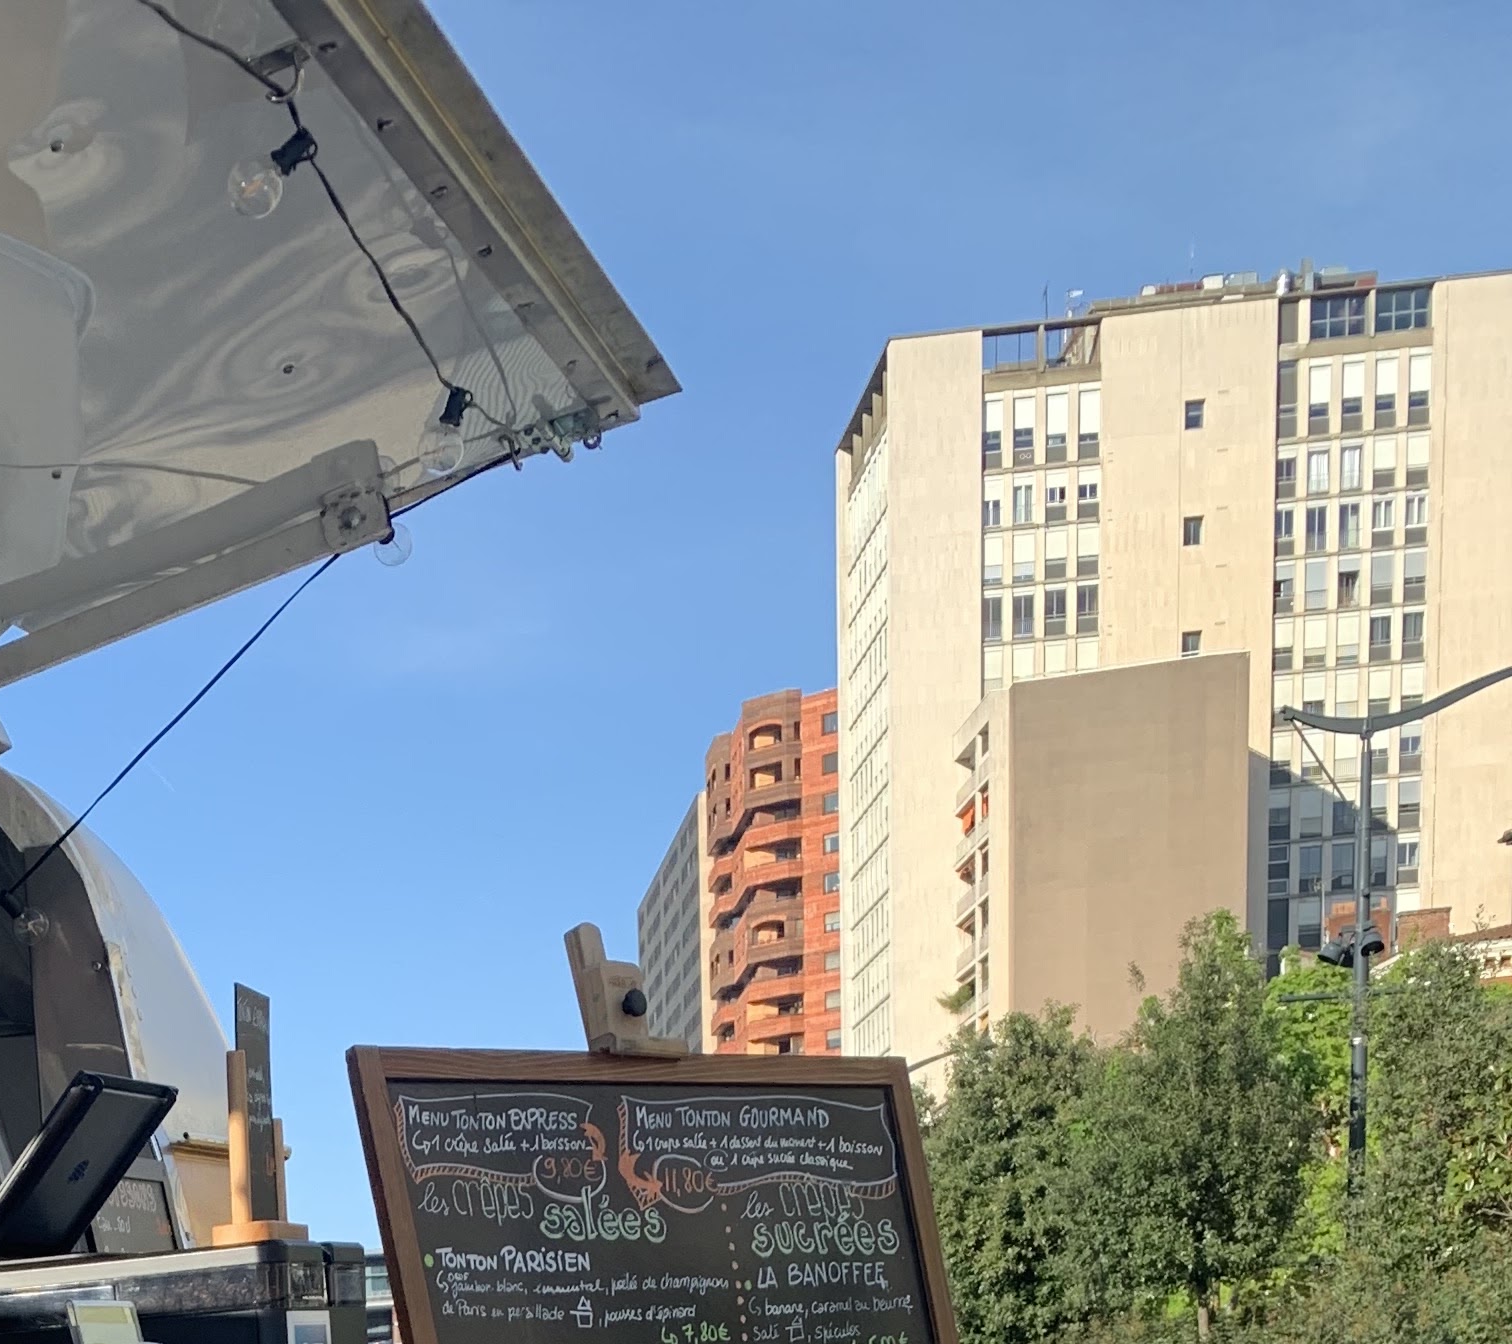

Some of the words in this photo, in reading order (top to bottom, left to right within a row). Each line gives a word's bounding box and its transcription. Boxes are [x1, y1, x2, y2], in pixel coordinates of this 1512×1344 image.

[451, 1109, 506, 1130] TONTON
[508, 1108, 577, 1130] EXPRESS
[676, 1107, 731, 1127] TONTON
[739, 1106, 830, 1128] GOURMAND
[838, 1136, 884, 1156] boisson
[540, 1186, 667, 1242] salées
[751, 1211, 900, 1258] sucrées
[436, 1247, 497, 1271] TONTON
[757, 1266, 779, 1289] LA
